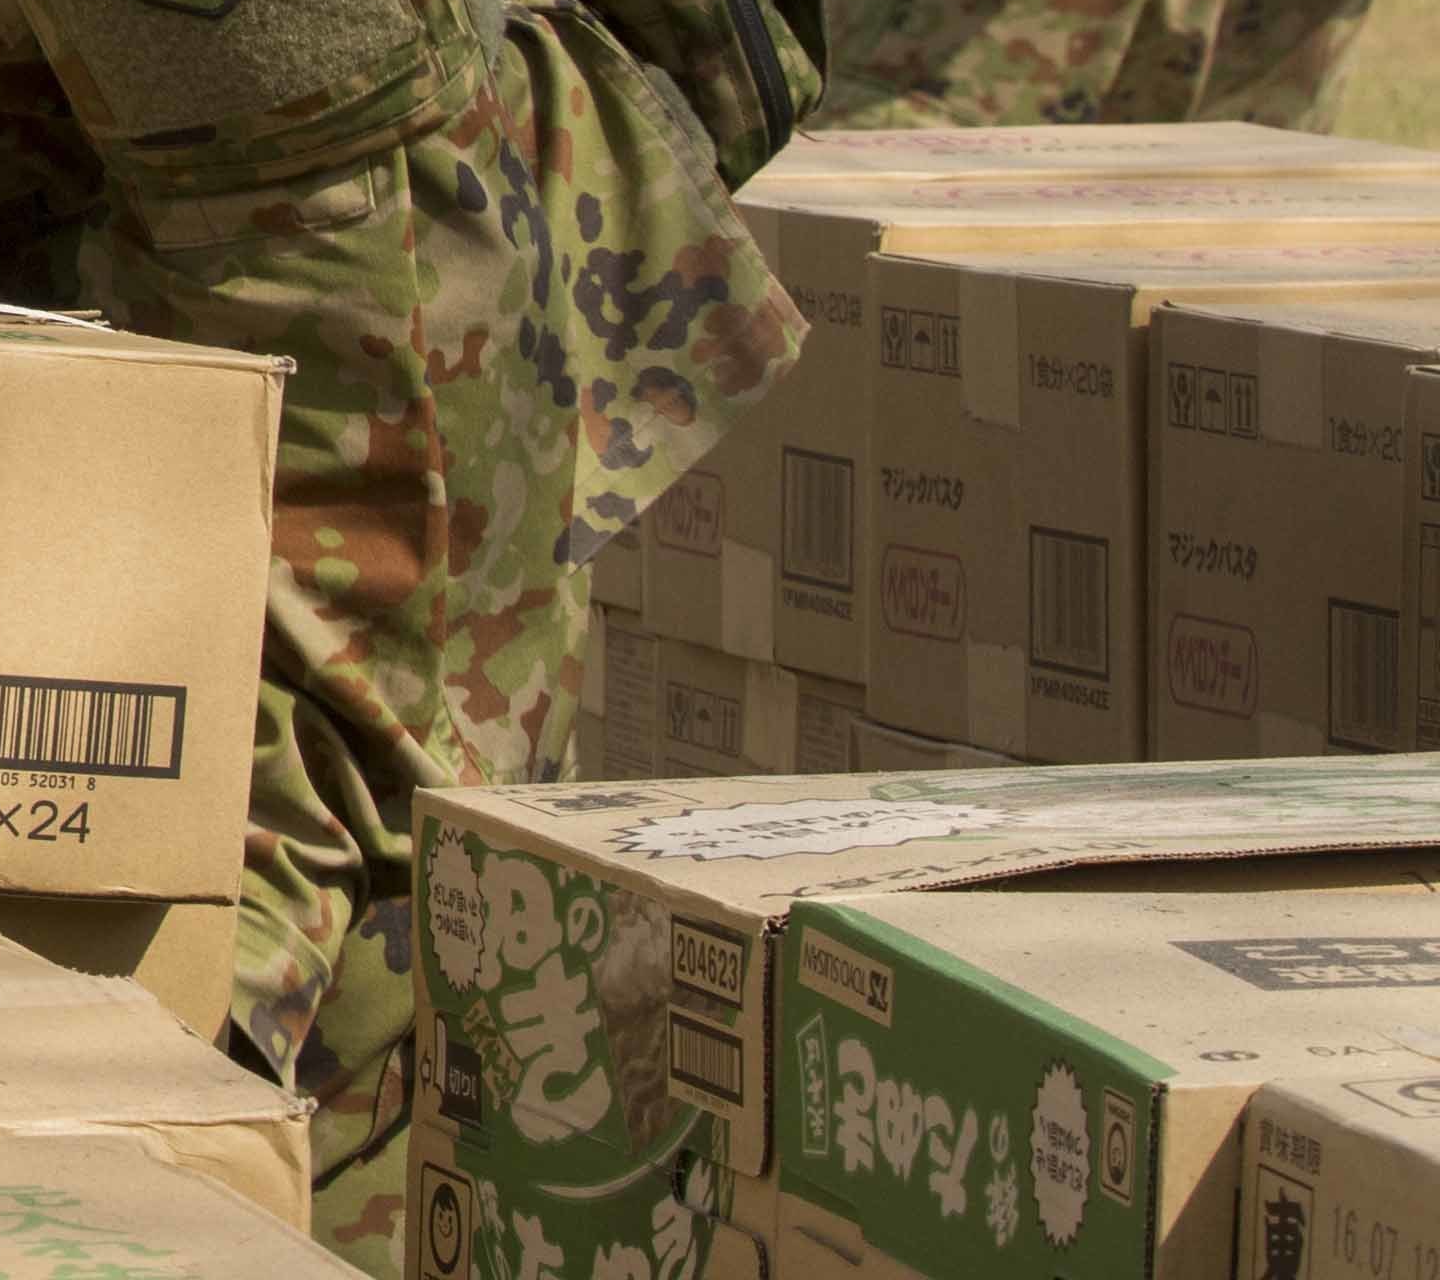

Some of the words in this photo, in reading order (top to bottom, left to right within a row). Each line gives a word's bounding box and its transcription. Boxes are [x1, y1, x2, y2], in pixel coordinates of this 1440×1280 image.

[28, 772, 75, 790] 52031
[86, 776, 96, 792] 8
[676, 935, 739, 992] 204623
[831, 1039, 979, 1220] たぬき
